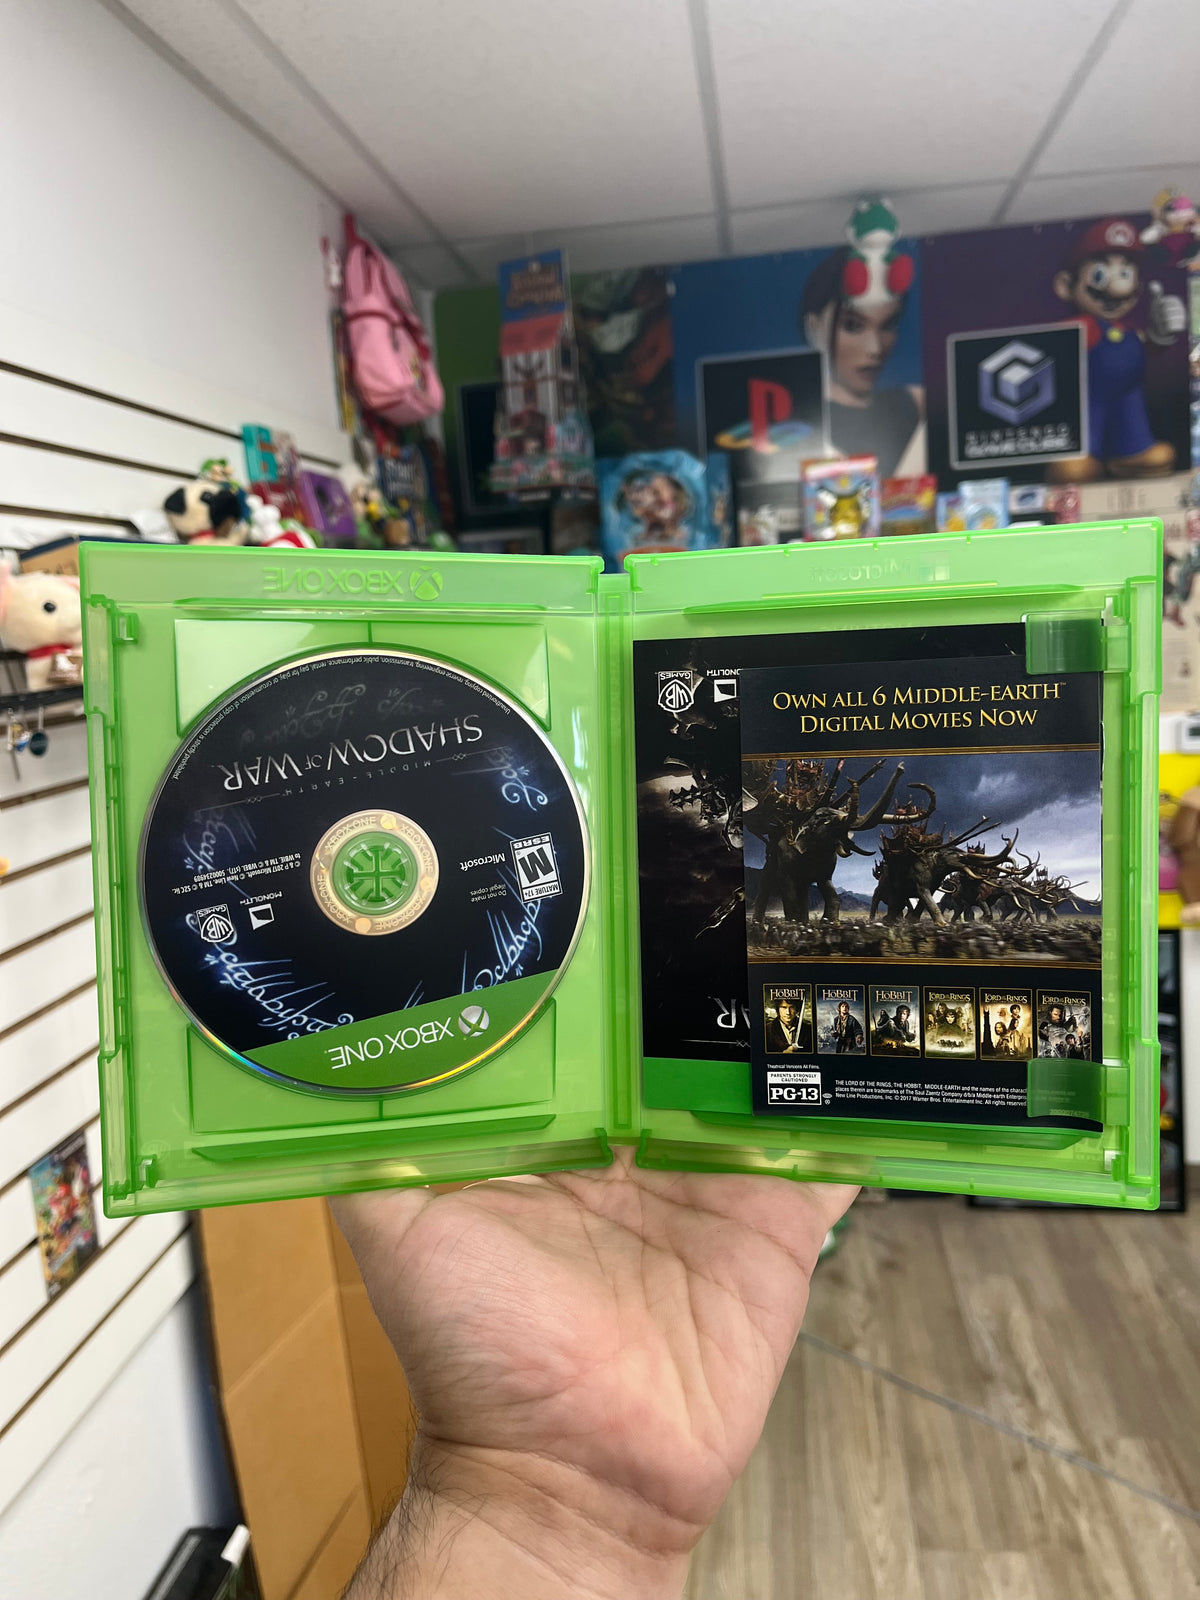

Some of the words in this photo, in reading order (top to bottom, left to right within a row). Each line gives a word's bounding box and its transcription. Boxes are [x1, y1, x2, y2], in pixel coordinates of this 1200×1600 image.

[328, 656, 363, 666] performance,
[363, 656, 380, 665] public
[381, 657, 414, 668] transmission,
[291, 669, 300, 677] for
[300, 665, 310, 673] pay
[312, 662, 327, 672] rental,
[414, 661, 446, 676] engineering,
[279, 672, 291, 681] play,
[446, 671, 464, 683] reverse
[659, 671, 691, 681] GAMES
[240, 680, 273, 703] circumvention
[464, 680, 484, 696] copying,
[482, 690, 511, 715] Unauthorized
[773, 691, 827, 711] OWN
[832, 691, 868, 708] ALL
[872, 685, 887, 706] 6
[893, 683, 1060, 706] MIDDLE-EARTH
[223, 703, 235, 717] copy
[233, 700, 241, 710] of
[203, 711, 225, 737] protection
[800, 715, 885, 734] DIGITAL
[889, 711, 973, 730] MOVIES
[979, 708, 1039, 727] NOW
[199, 732, 206, 741] is
[328, 714, 483, 771] SHADOW
[189, 738, 202, 756] strictly
[172, 752, 191, 781] prohibited
[305, 755, 322, 770] OF
[218, 752, 303, 791] WAR
[512, 836, 551, 850] ESRB
[269, 858, 279, 866] TM
[460, 852, 506, 873] Microsoft
[519, 847, 554, 883] M
[246, 867, 272, 880] Microsoft.
[273, 865, 284, 874] 2017
[203, 880, 213, 889] TM
[213, 878, 227, 886] Line.
[489, 884, 507, 894] illegal
[498, 889, 507, 897] Do
[524, 889, 535, 899] 17+
[535, 884, 559, 897] MATURE
[471, 895, 487, 904] make
[198, 905, 227, 917] GAMES
[770, 988, 805, 1001] HOBBIT
[822, 989, 858, 1002] HOBBIT
[875, 990, 913, 1003] HOBBIT
[929, 991, 946, 1002] LORD
[950, 993, 971, 1002] RINGS
[984, 993, 1002, 1003] LORD
[1006, 995, 1028, 1004] RINGS
[1042, 995, 1061, 1005] LORD
[1064, 996, 1087, 1006] RINGS
[384, 1017, 454, 1055] XBOX
[327, 1038, 385, 1070] ONE
[924, 1083, 961, 1091] MIDDLE-EARTH
[770, 1087, 819, 1101] PG-13
[942, 1097, 975, 1105] Entertainment
